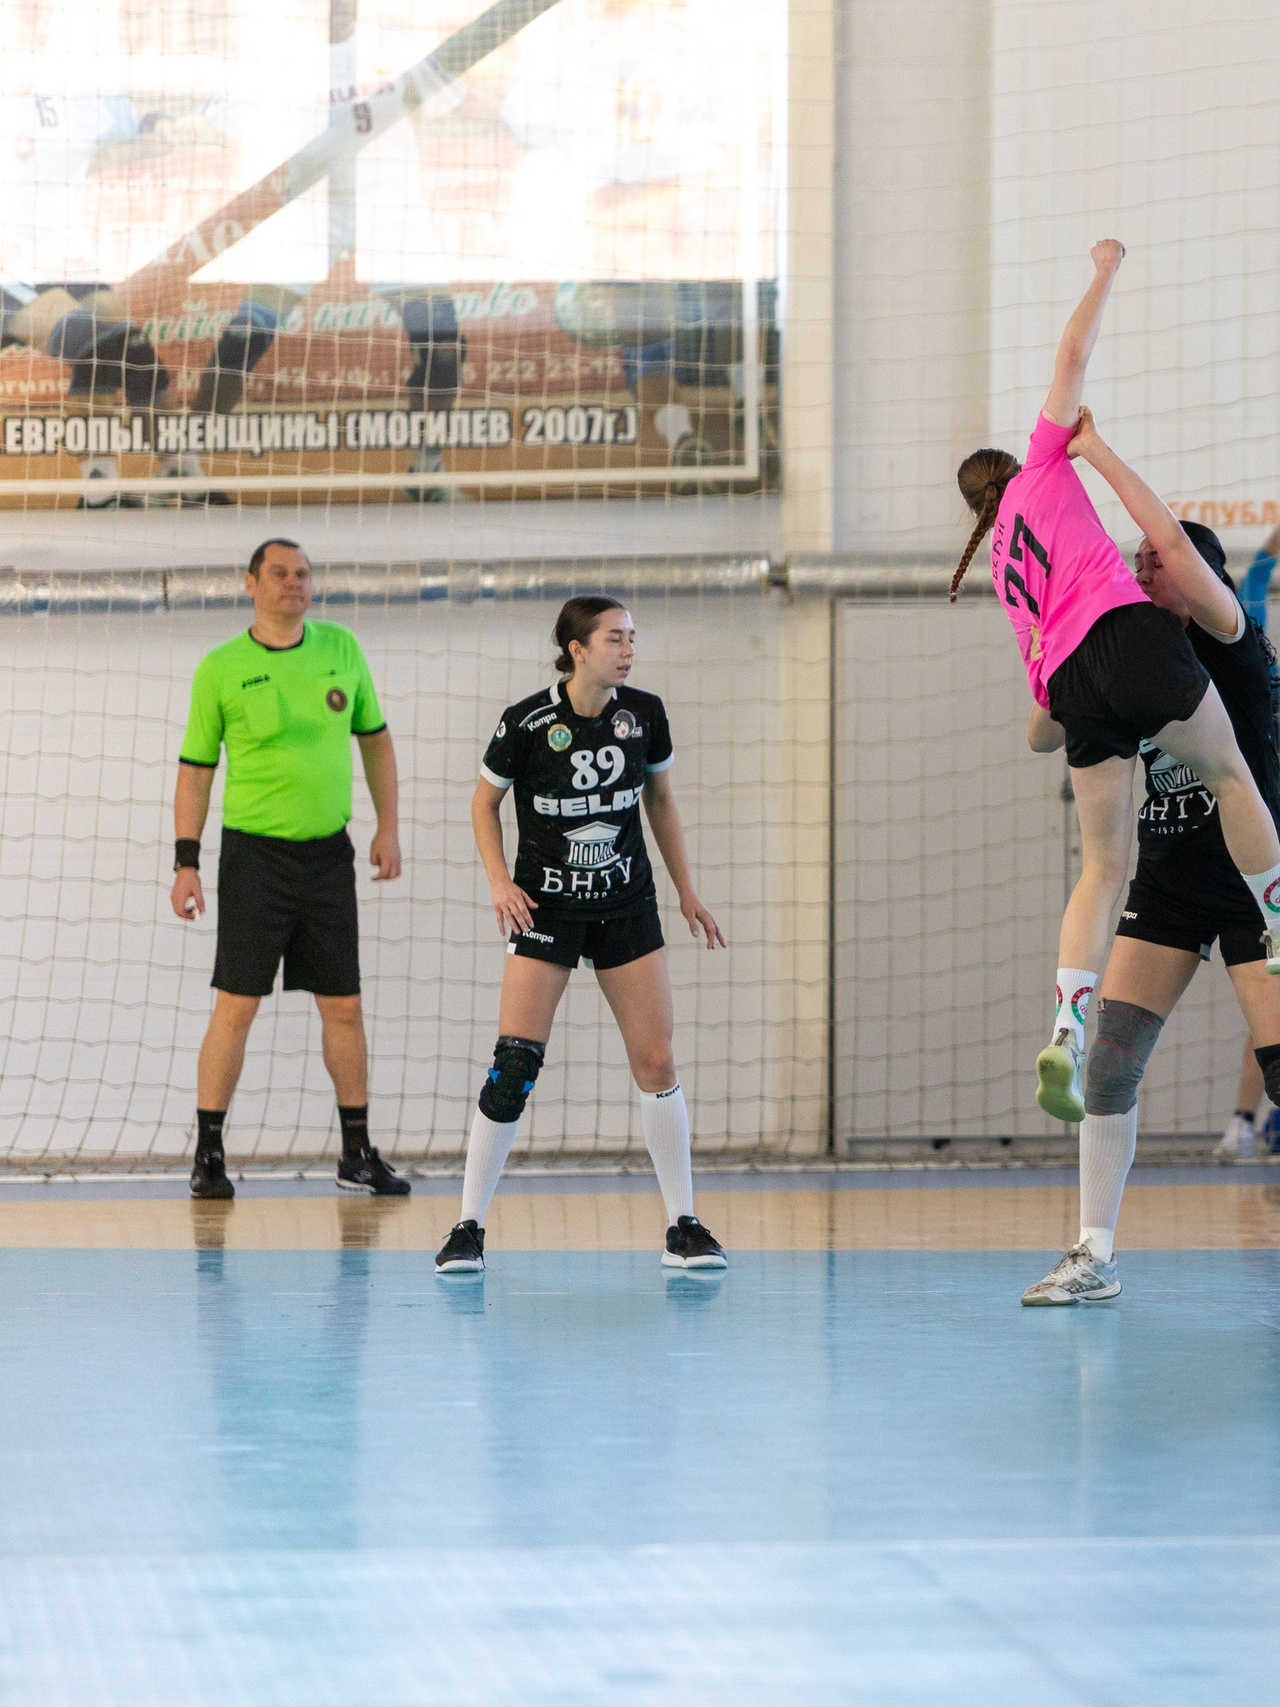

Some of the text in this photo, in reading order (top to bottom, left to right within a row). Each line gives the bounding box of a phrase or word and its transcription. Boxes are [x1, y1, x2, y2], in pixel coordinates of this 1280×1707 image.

[157, 413, 339, 457] ЖЕНЩИНЫ
[346, 409, 511, 450] (МОГИЛЕВ
[526, 711, 558, 733] Kempa
[570, 745, 626, 791] 89
[540, 856, 632, 893] БНТУ
